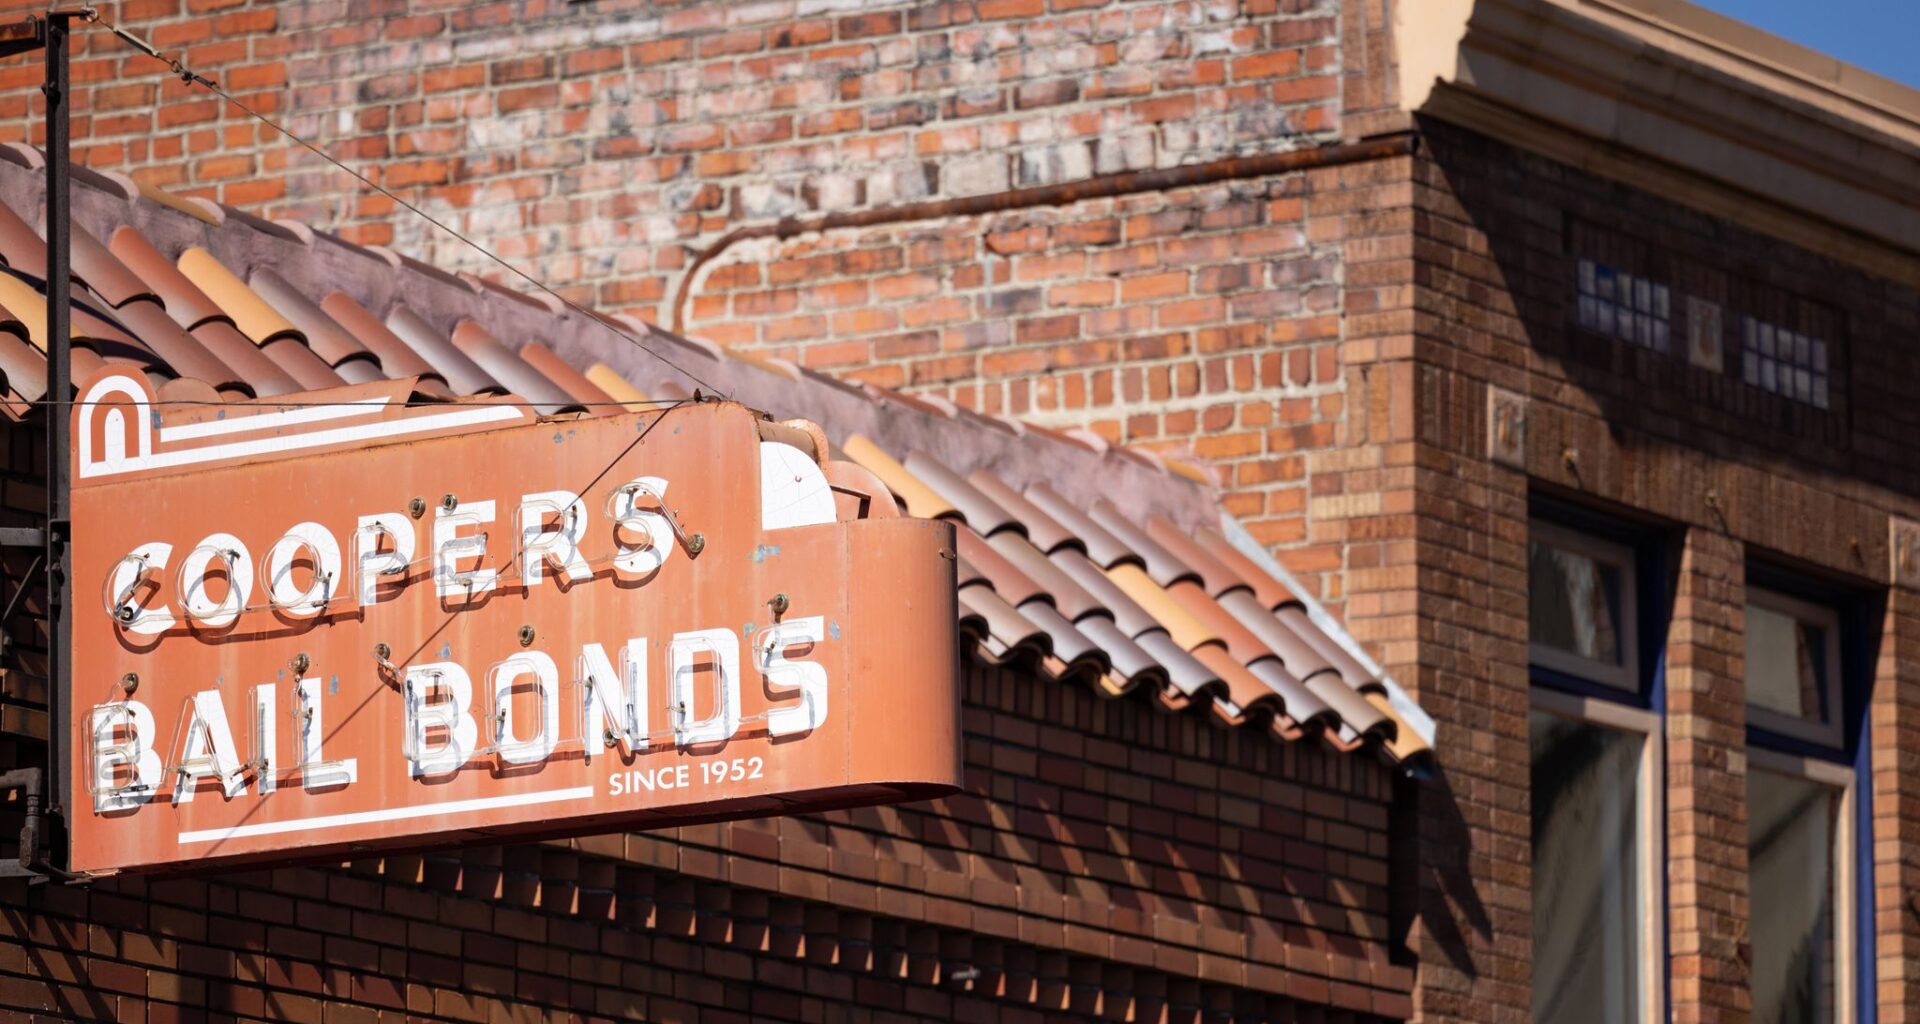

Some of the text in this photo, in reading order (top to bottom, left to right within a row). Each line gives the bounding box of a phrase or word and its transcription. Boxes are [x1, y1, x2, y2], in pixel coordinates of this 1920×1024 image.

[109, 475, 676, 635] COOPERS
[89, 615, 829, 813] BAIL BONDS
[608, 756, 764, 796] SINCE 1952
